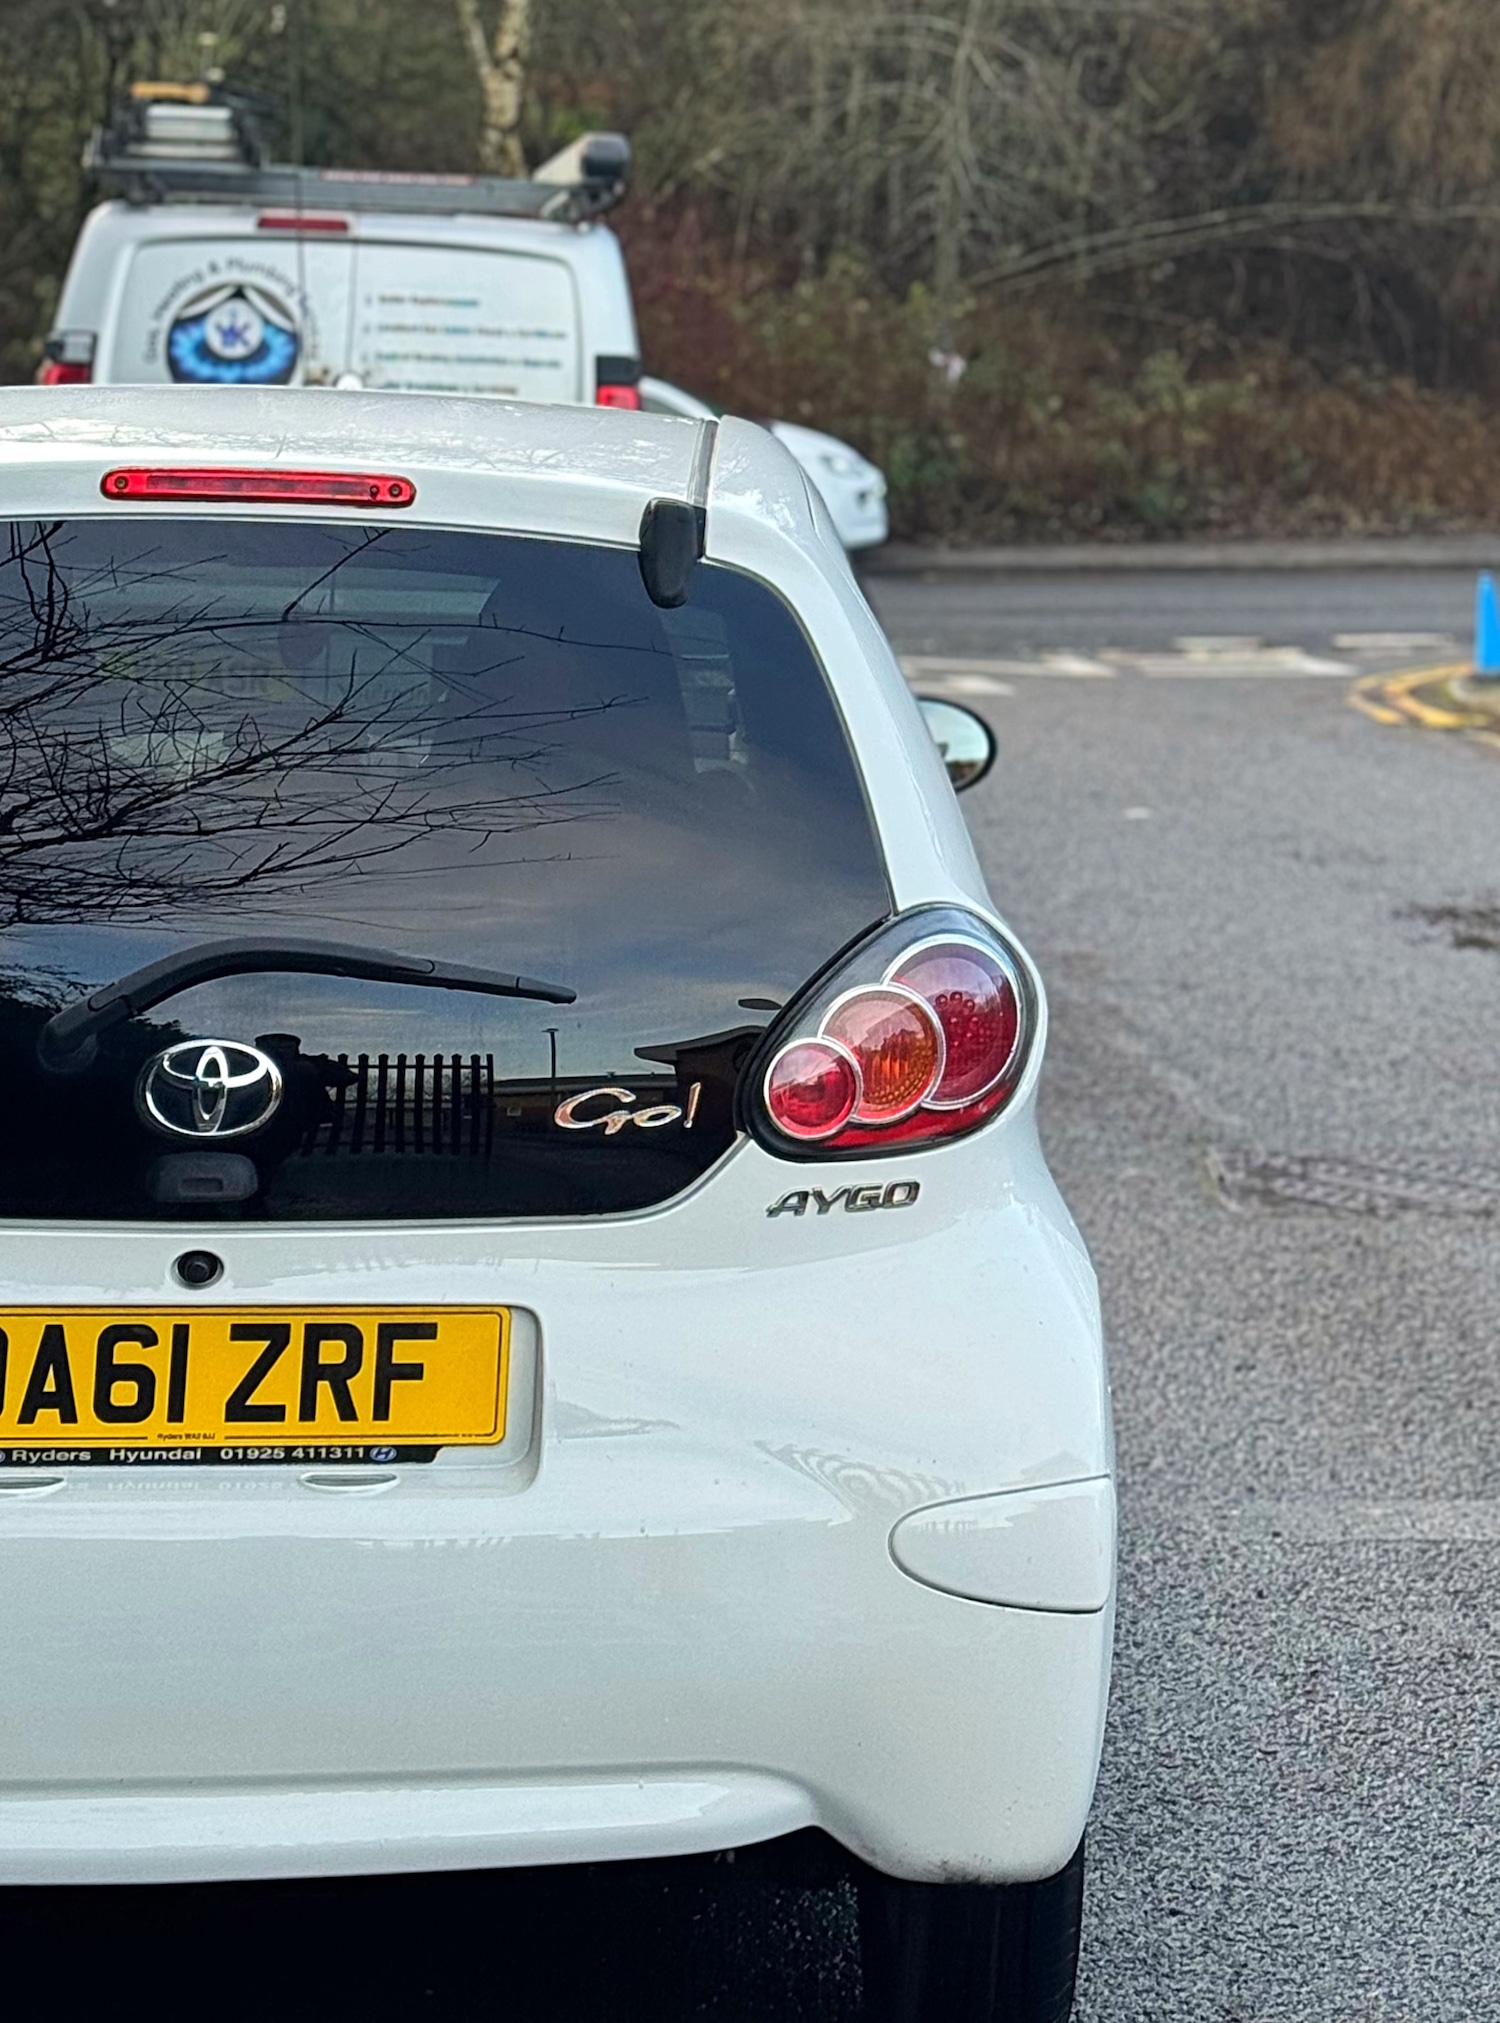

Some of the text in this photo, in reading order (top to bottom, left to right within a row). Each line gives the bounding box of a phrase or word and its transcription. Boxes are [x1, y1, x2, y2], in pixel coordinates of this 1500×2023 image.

[554, 1083, 700, 1135] Go!
[766, 1179, 921, 1217] AYGO
[0, 1322, 438, 1425] A61 ZRF
[11, 1449, 92, 1464] Ryders
[220, 1447, 285, 1460] 01925
[291, 1446, 365, 1460] 411311
